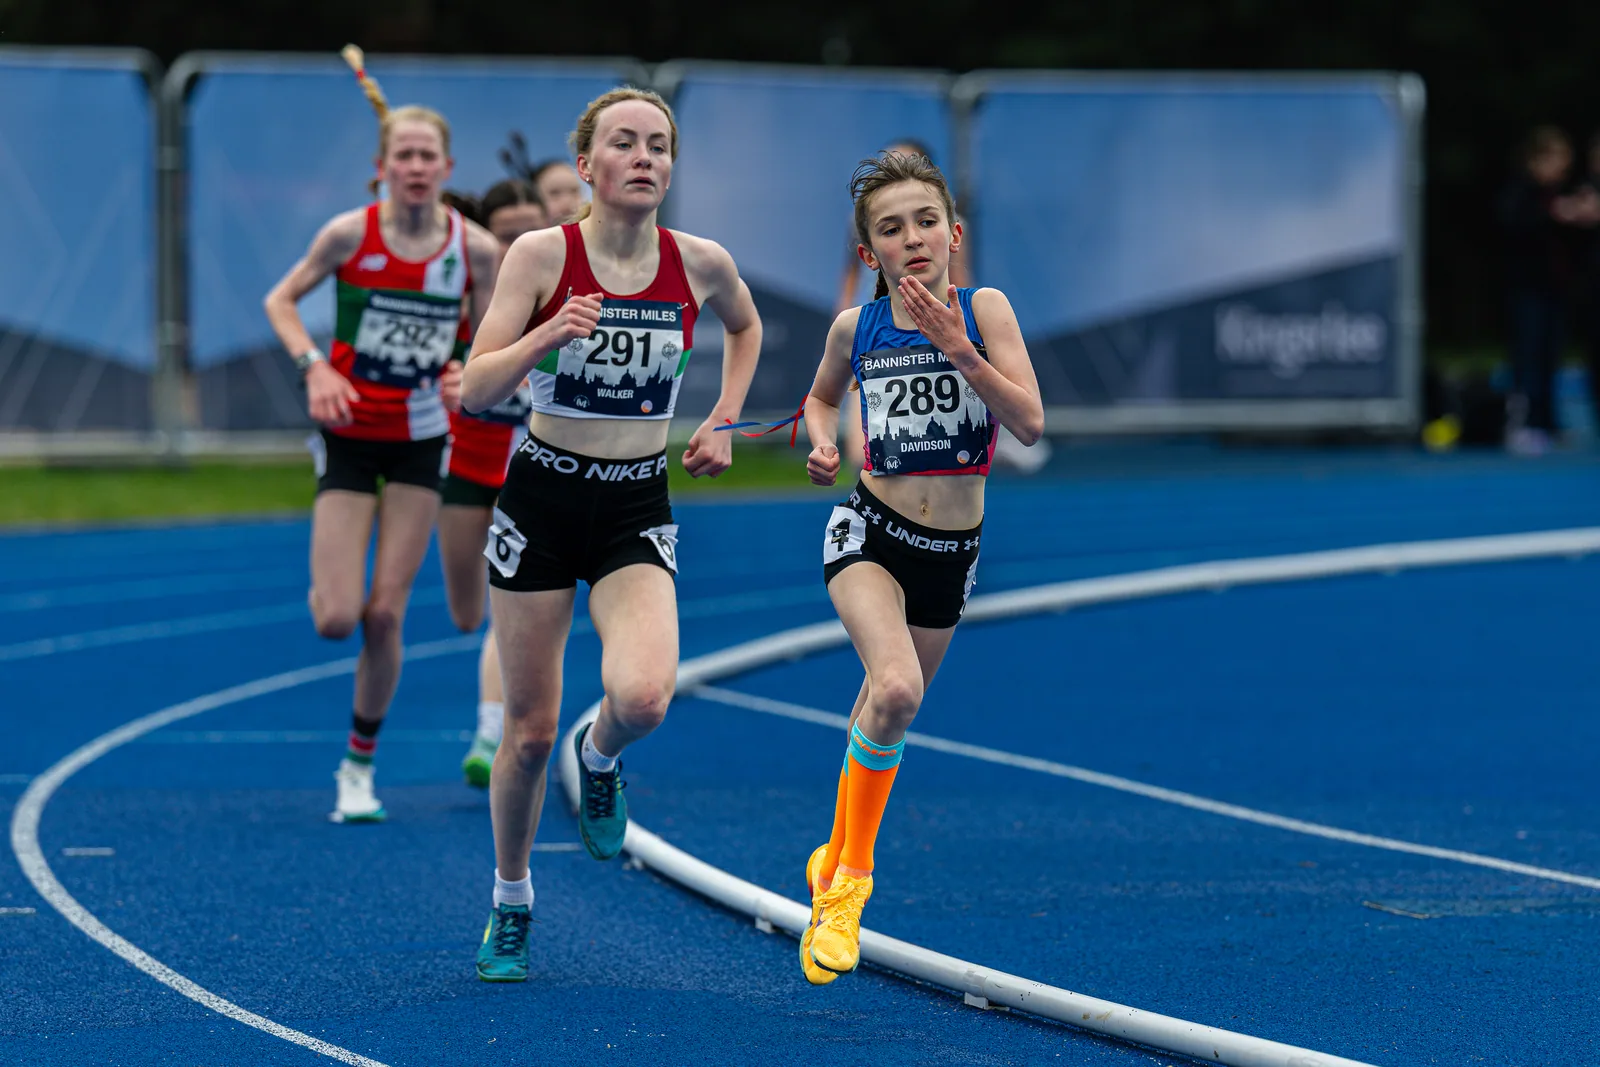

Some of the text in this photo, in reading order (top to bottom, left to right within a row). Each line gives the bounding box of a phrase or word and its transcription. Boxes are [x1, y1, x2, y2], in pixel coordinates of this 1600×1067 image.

[599, 307, 677, 322] NISTER MILES
[382, 317, 438, 351] 292
[585, 328, 652, 368] 291
[864, 352, 935, 371] BANNISTER
[597, 387, 634, 399] WALKER
[884, 374, 960, 419] 289
[519, 438, 579, 474] PRO
[585, 460, 655, 482] NIKE
[901, 439, 952, 453] DAVIDSON
[831, 517, 851, 552] 4
[885, 521, 959, 553] UNDER
